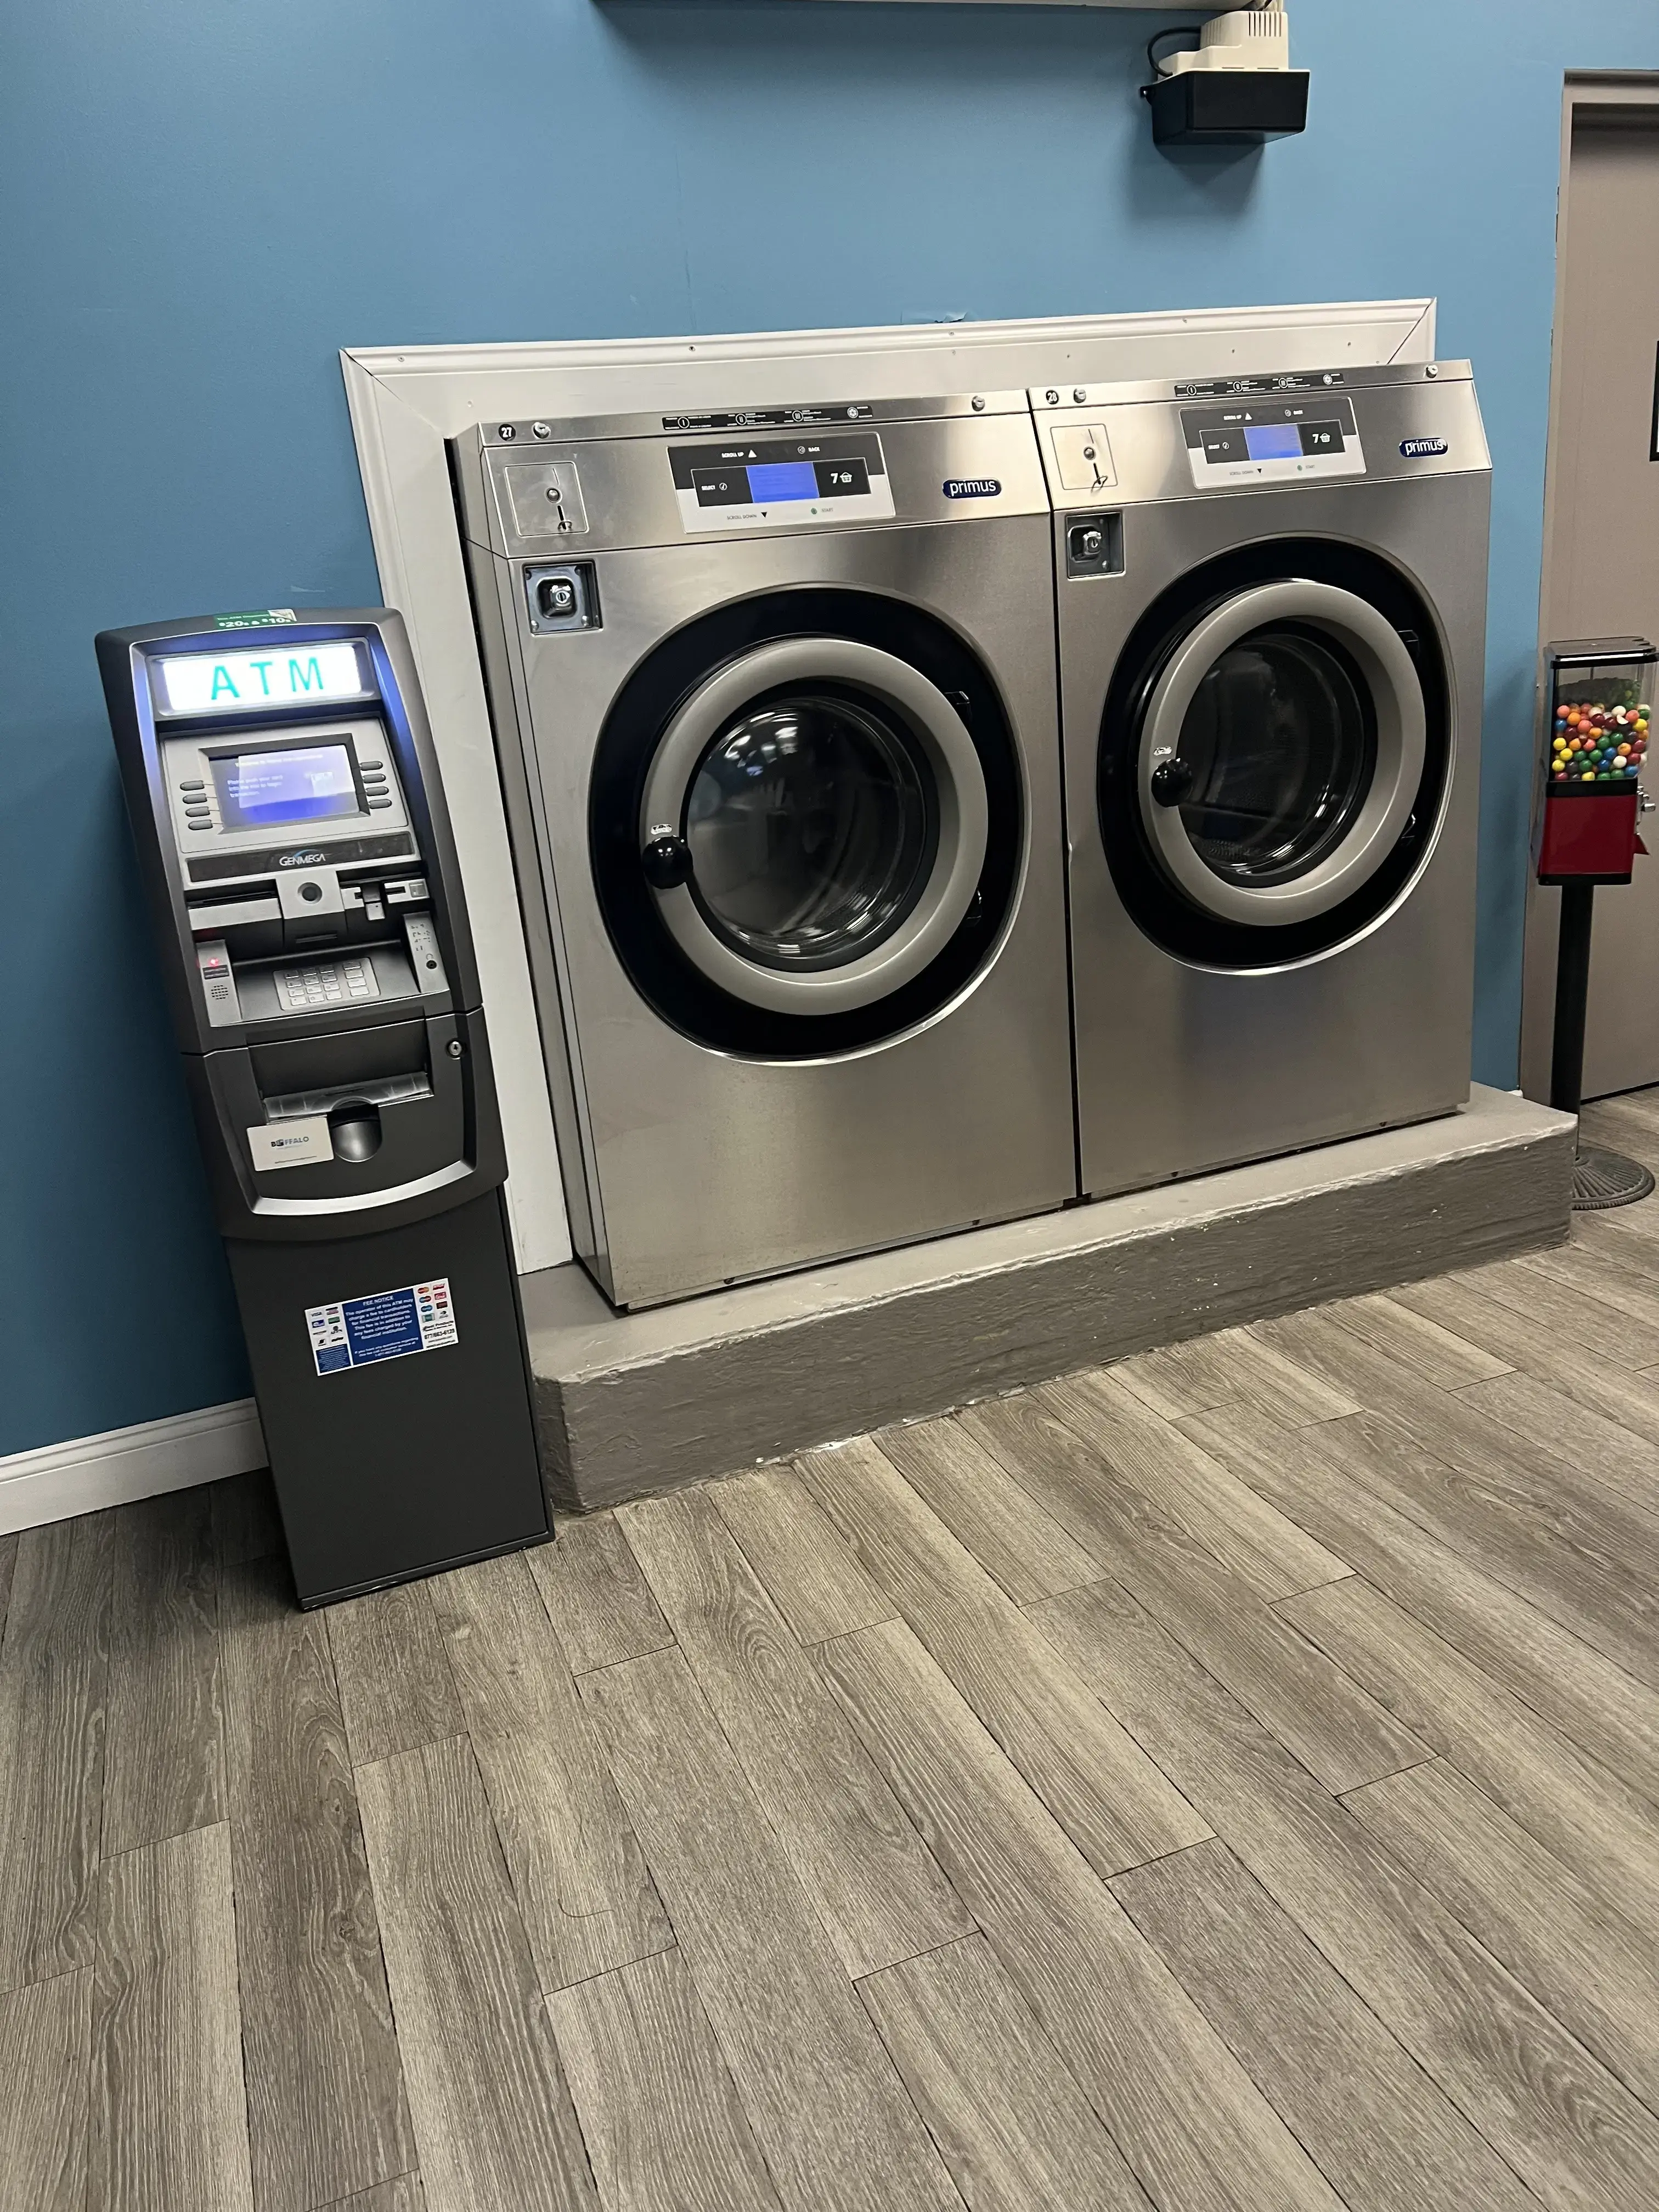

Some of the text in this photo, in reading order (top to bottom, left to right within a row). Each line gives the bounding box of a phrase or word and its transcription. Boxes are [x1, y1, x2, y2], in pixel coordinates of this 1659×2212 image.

[1047, 392, 1058, 403] 28
[501, 427, 512, 438] 27
[1312, 433, 1319, 443] 7
[1404, 439, 1444, 456] primus
[830, 472, 839, 484] 7
[949, 480, 996, 497] primus
[211, 657, 324, 701] ATM
[279, 853, 326, 866] GENMEGA
